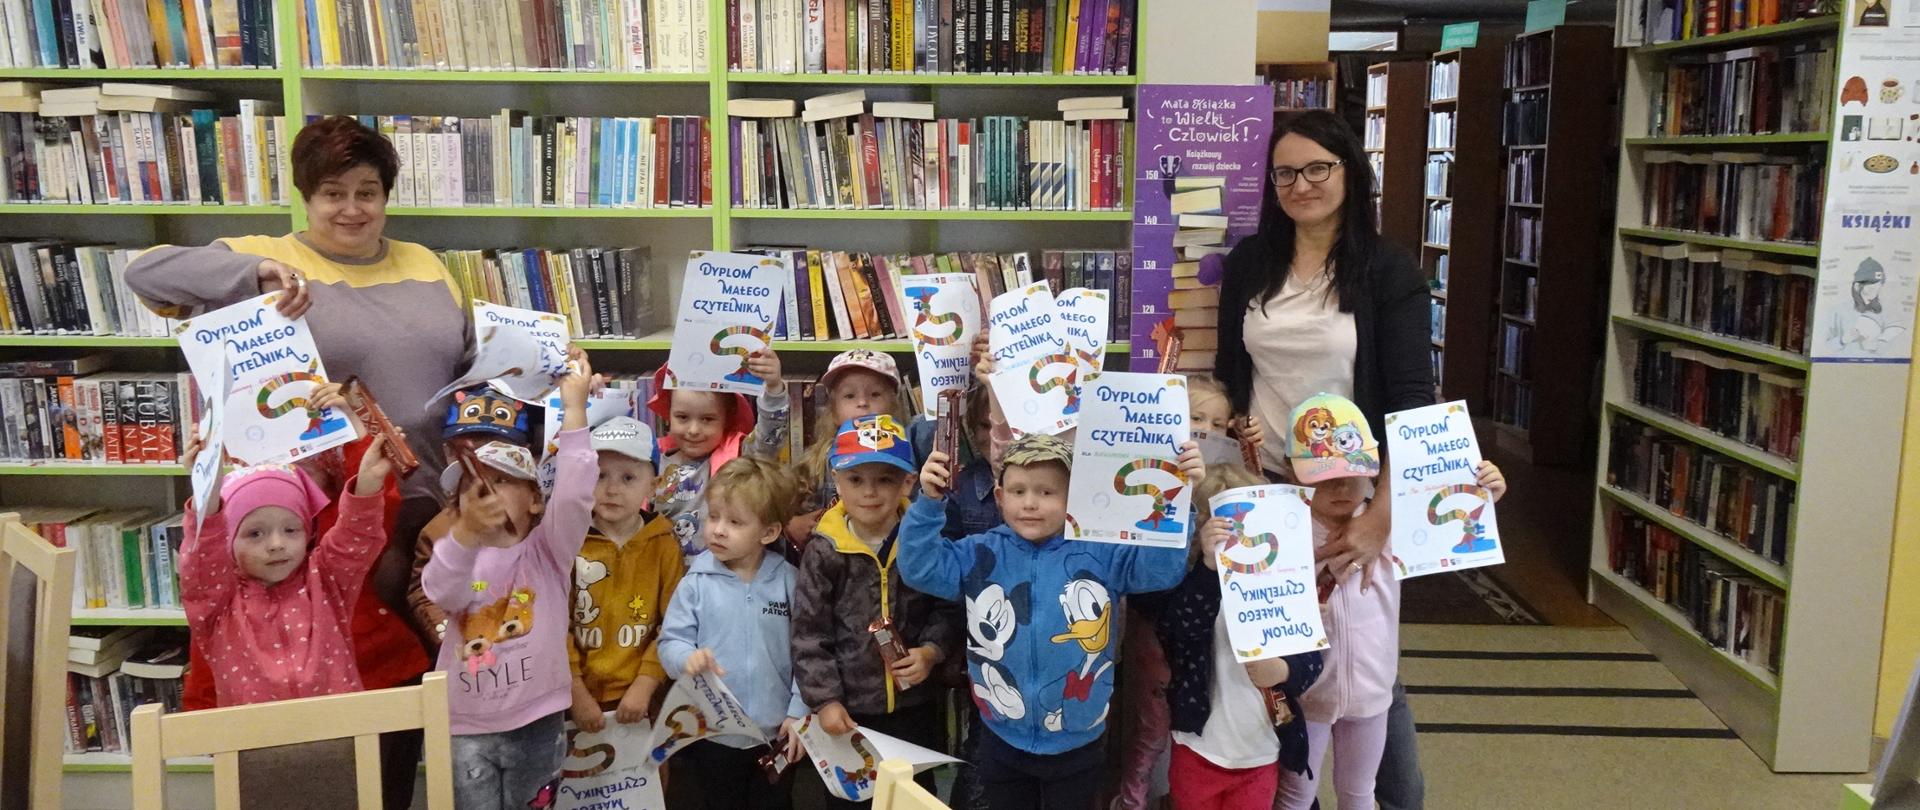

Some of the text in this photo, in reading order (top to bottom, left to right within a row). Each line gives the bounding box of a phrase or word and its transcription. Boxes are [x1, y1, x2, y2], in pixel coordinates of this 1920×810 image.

[1161, 100, 1189, 109] Mała
[1161, 111, 1231, 129] to Wielki
[1186, 150, 1222, 160] Książkowy
[1145, 170, 1158, 180] 150
[1192, 161, 1241, 171] rozwój dziecka
[1144, 216, 1158, 225] 140
[1842, 211, 1911, 232] KSIĄŻKI
[700, 263, 758, 279] DYPLOM
[1143, 260, 1156, 270] 130
[718, 280, 770, 297] MAŁEGO
[693, 298, 770, 323] CZYTELNIKA
[990, 298, 1029, 326] YPLOM
[1060, 312, 1096, 324] AŁEGO
[1142, 304, 1155, 314] 120
[196, 309, 265, 344] DYPLOM
[1001, 313, 1051, 336] MAŁEGO
[226, 325, 295, 354] MAŁEGO
[231, 346, 309, 381] YTELNIKA
[923, 351, 968, 372] TELNIKA
[1142, 349, 1154, 358] 110
[1096, 386, 1166, 405] DYPLOM
[137, 383, 157, 456] HUBAL
[156, 383, 172, 454] ZAWISZA
[1120, 405, 1182, 425] MAŁEGO
[1399, 415, 1450, 440] DYPLOM
[1091, 427, 1185, 455] CZYTELNIKA
[1421, 437, 1470, 456] MAŁEGO
[1403, 457, 1481, 482] CZYTELNIKA
[1230, 580, 1305, 604] CZYTELNIKA
[762, 608, 791, 617] PATRO
[768, 600, 788, 609] PAW
[1238, 606, 1291, 623] MAŁEGO
[1261, 622, 1314, 646] DYPLOM
[460, 656, 534, 693] STYLE
[561, 777, 647, 800] CZYTELNIKA
